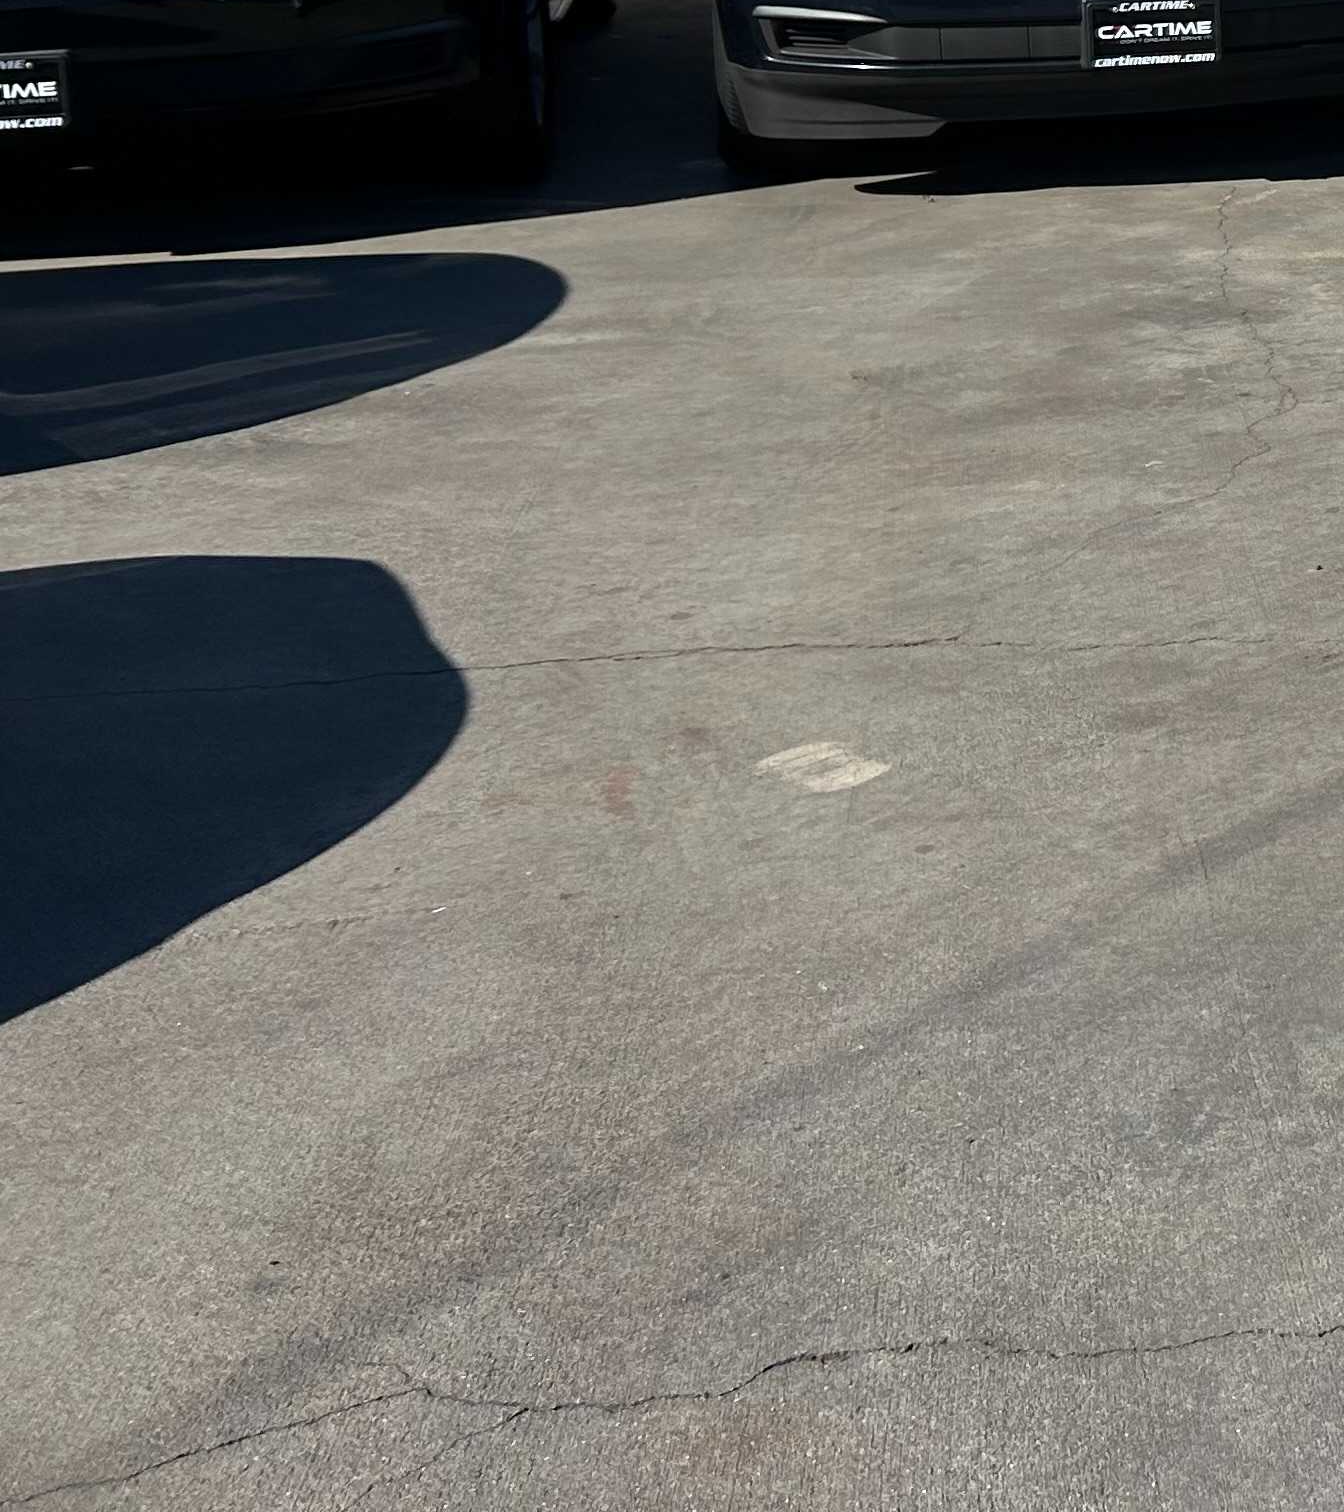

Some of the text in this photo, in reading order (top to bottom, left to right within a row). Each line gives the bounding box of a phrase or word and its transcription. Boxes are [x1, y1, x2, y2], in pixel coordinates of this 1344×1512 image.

[1119, 0, 1189, 12] CARTIME
[1097, 20, 1213, 40] CARTIME
[1094, 52, 1216, 68] cartimenow.com
